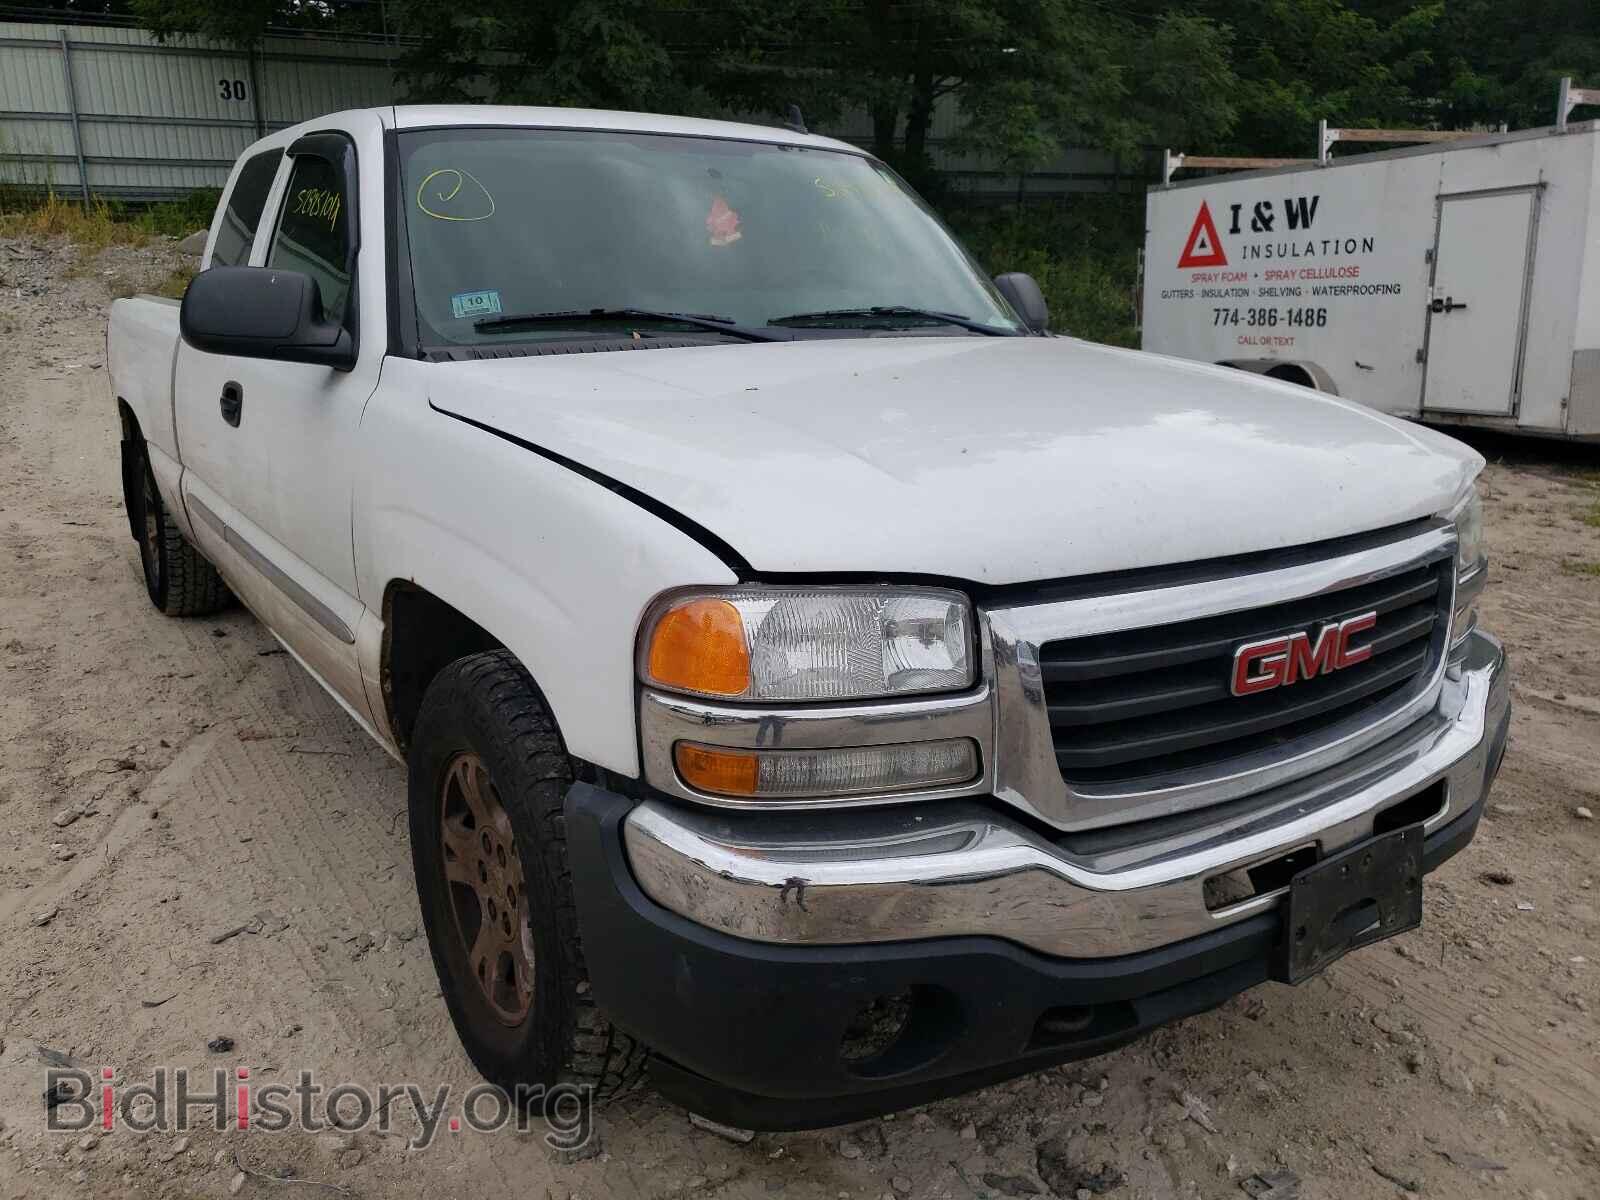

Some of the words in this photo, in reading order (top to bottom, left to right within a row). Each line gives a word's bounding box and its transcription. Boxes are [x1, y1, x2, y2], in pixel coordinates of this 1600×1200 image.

[219, 80, 246, 100] 30
[1229, 203, 1242, 235] I
[1250, 201, 1275, 233] &
[1285, 195, 1320, 230] W
[1241, 237, 1375, 260] INSULATION
[1191, 273, 1220, 284] SPRAY
[1221, 271, 1248, 282] FOAM
[1264, 269, 1297, 281] SPRAY
[1299, 266, 1360, 280] CELLULOSE
[467, 295, 484, 306] 10
[1161, 288, 1194, 299] GUTTERS
[1201, 287, 1250, 298] INSULATION
[1258, 286, 1302, 298] SHELVING
[1312, 283, 1401, 297] WATERPROOFING
[1213, 307, 1328, 328] 774-386-1486
[1238, 335, 1259, 346] CALL
[1260, 335, 1273, 346] OR
[1274, 336, 1296, 346] TEXT
[1231, 610, 1377, 697] GMC
